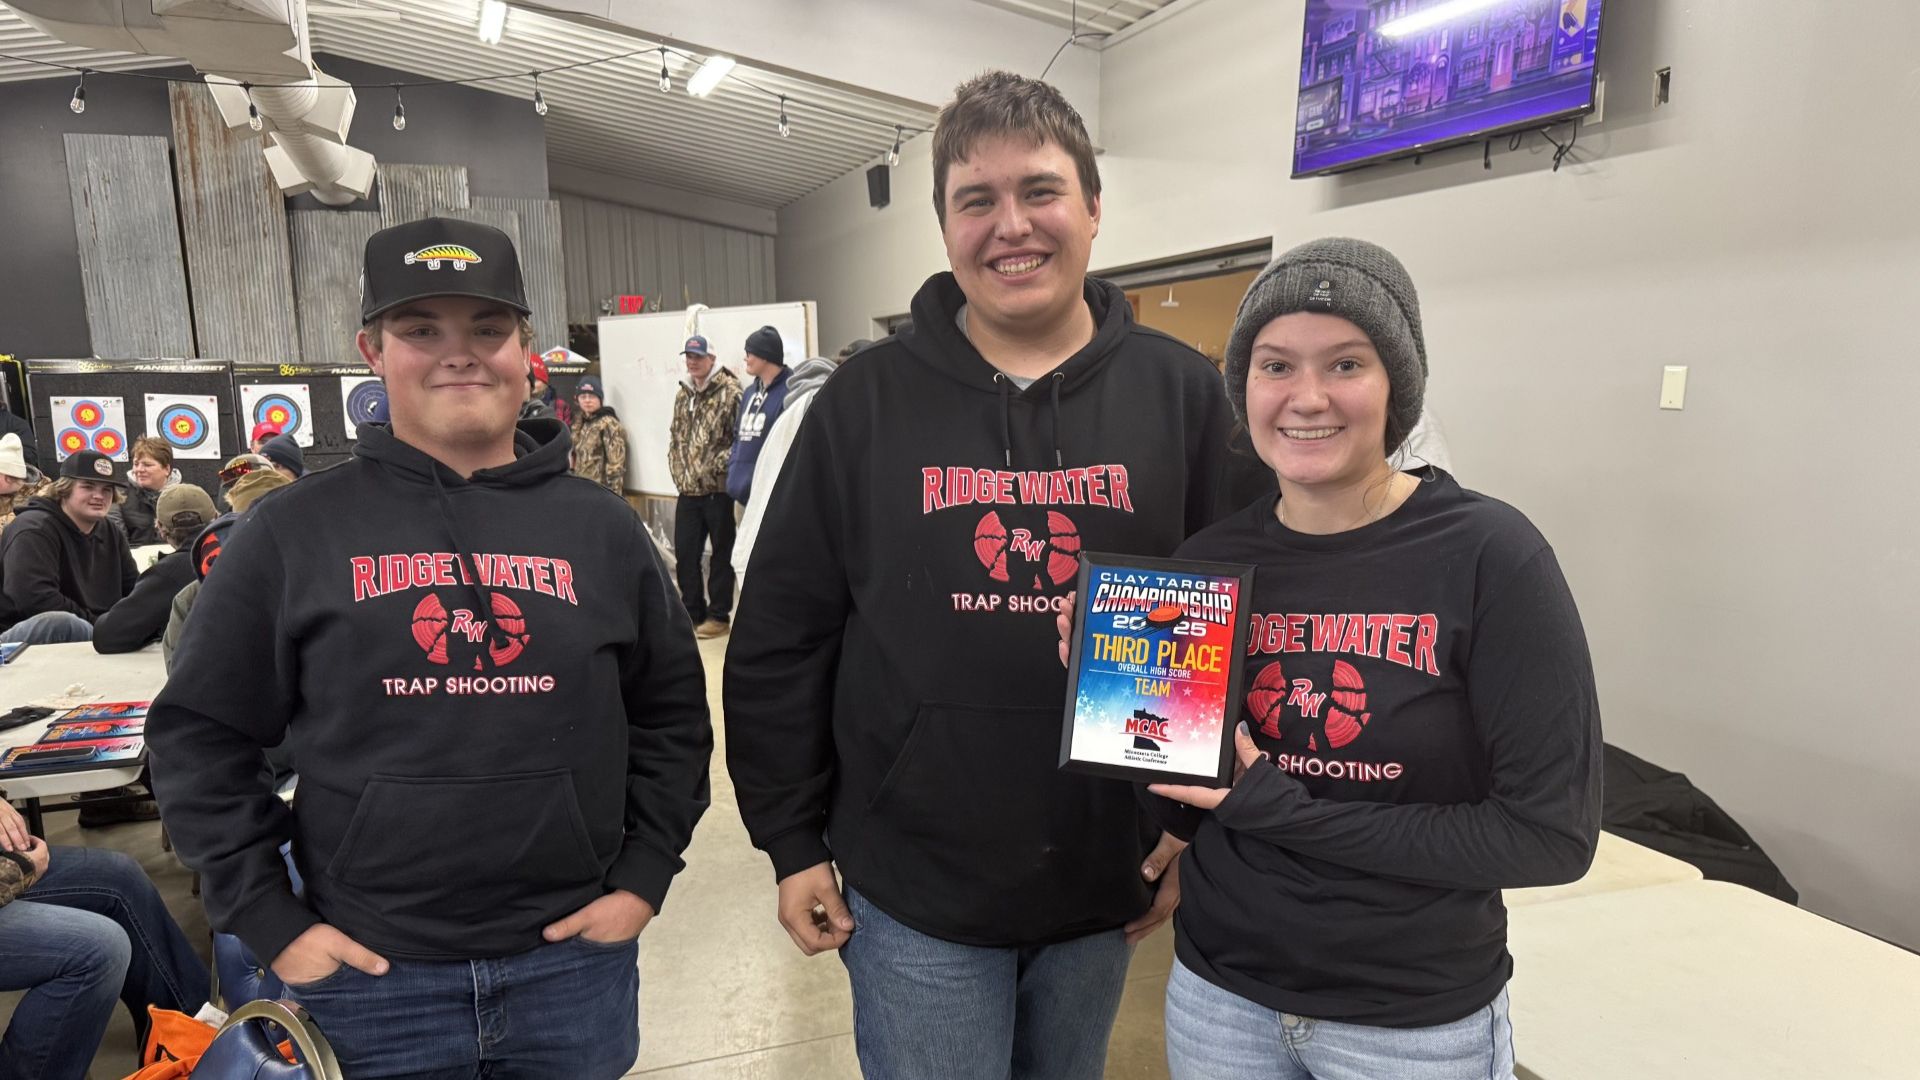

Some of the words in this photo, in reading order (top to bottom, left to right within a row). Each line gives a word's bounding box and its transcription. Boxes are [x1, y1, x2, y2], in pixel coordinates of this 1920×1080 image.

[921, 464, 1134, 514] RIDGEWATER
[1010, 528, 1046, 562] RW
[351, 552, 578, 605] RIDGEWATER
[1100, 572, 1149, 584] CLAY
[1156, 577, 1233, 592] TARGET
[951, 593, 1001, 612] TRAP
[1008, 595, 1062, 613] SHOO
[1091, 583, 1233, 626] CHAMPIONSHIP
[451, 609, 488, 642] RW
[1092, 633, 1150, 665] THIRD
[1156, 640, 1224, 673] PLACE
[1247, 613, 1440, 676] DGEWATER
[382, 677, 439, 695] TRAP
[445, 675, 556, 694] SHOOTING
[1118, 662, 1148, 674] OVERALL
[1150, 666, 1167, 676] HIGH
[1168, 669, 1191, 679] SCORE
[1135, 678, 1171, 697] TEAM
[1287, 678, 1326, 718] RW
[1125, 718, 1169, 737] MCAC
[1150, 752, 1169, 760] College
[1278, 753, 1403, 781] SHOOTING
